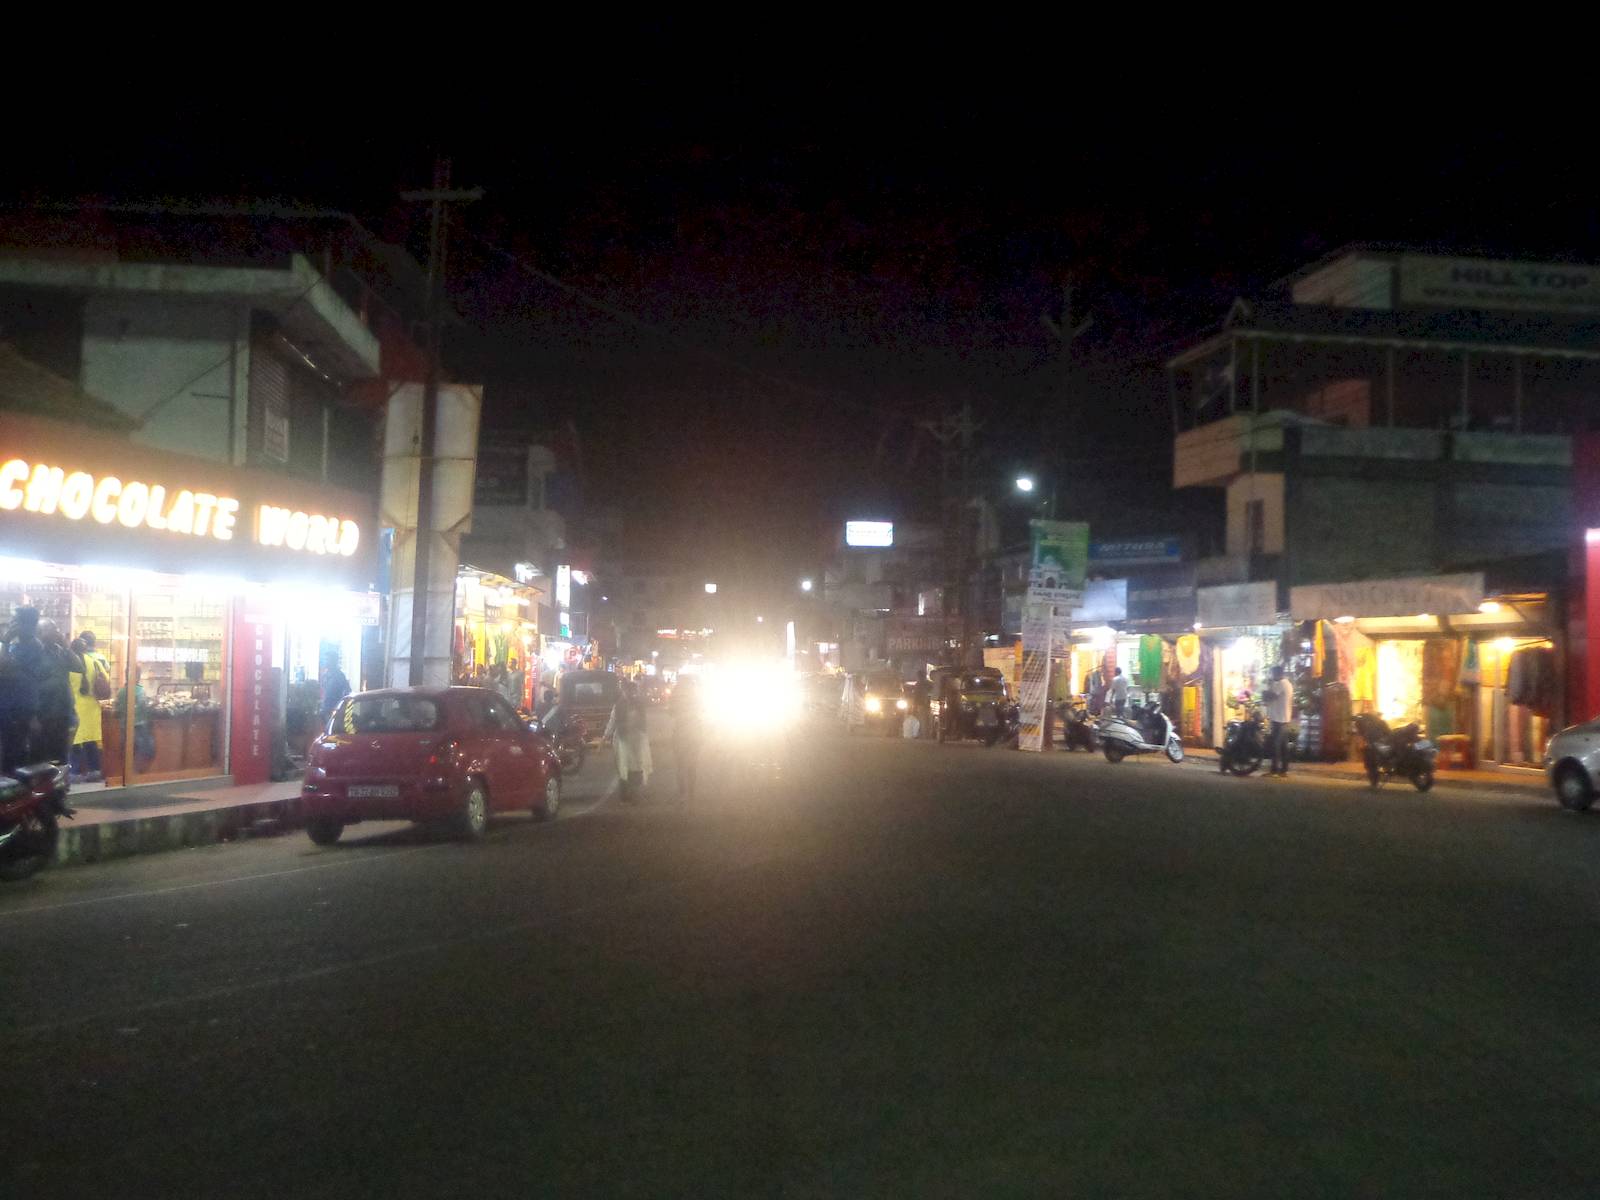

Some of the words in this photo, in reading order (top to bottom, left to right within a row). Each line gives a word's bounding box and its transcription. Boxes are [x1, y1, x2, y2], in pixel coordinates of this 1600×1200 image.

[1451, 267, 1518, 286] HILL
[1523, 270, 1589, 289] TOP
[0, 458, 240, 541] CHOCOLATE
[257, 504, 360, 557] WORLD
[253, 623, 263, 757] CHOCOLATE
